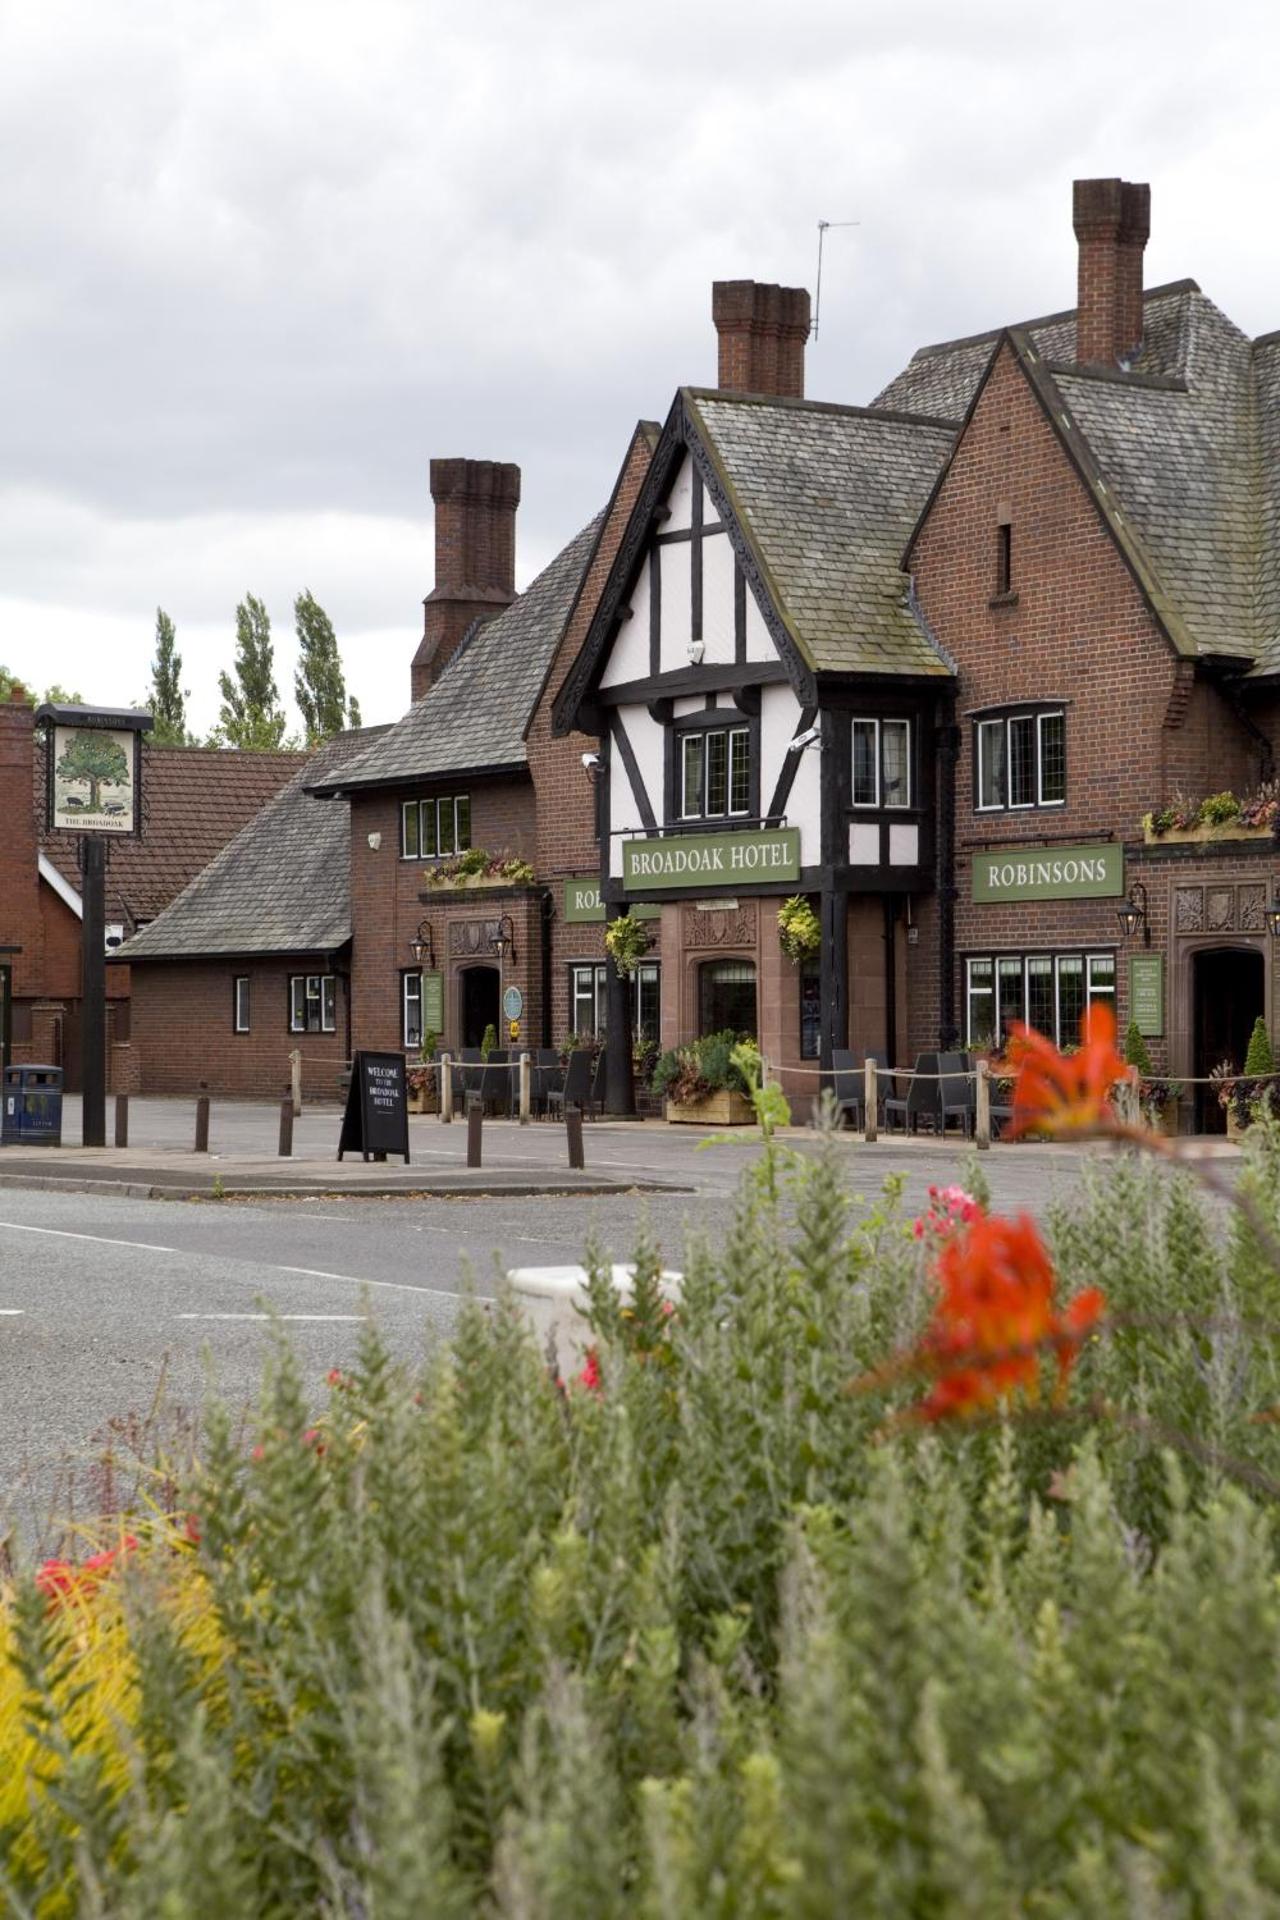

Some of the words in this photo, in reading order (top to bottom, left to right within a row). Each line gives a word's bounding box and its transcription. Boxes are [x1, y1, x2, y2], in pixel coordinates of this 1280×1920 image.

[631, 847, 724, 875] BROADOAK
[731, 842, 793, 869] HOTEL
[989, 858, 1107, 887] ROBINSONS
[367, 1066, 399, 1078] WELCOME
[374, 1097, 395, 1107] HOTEL
